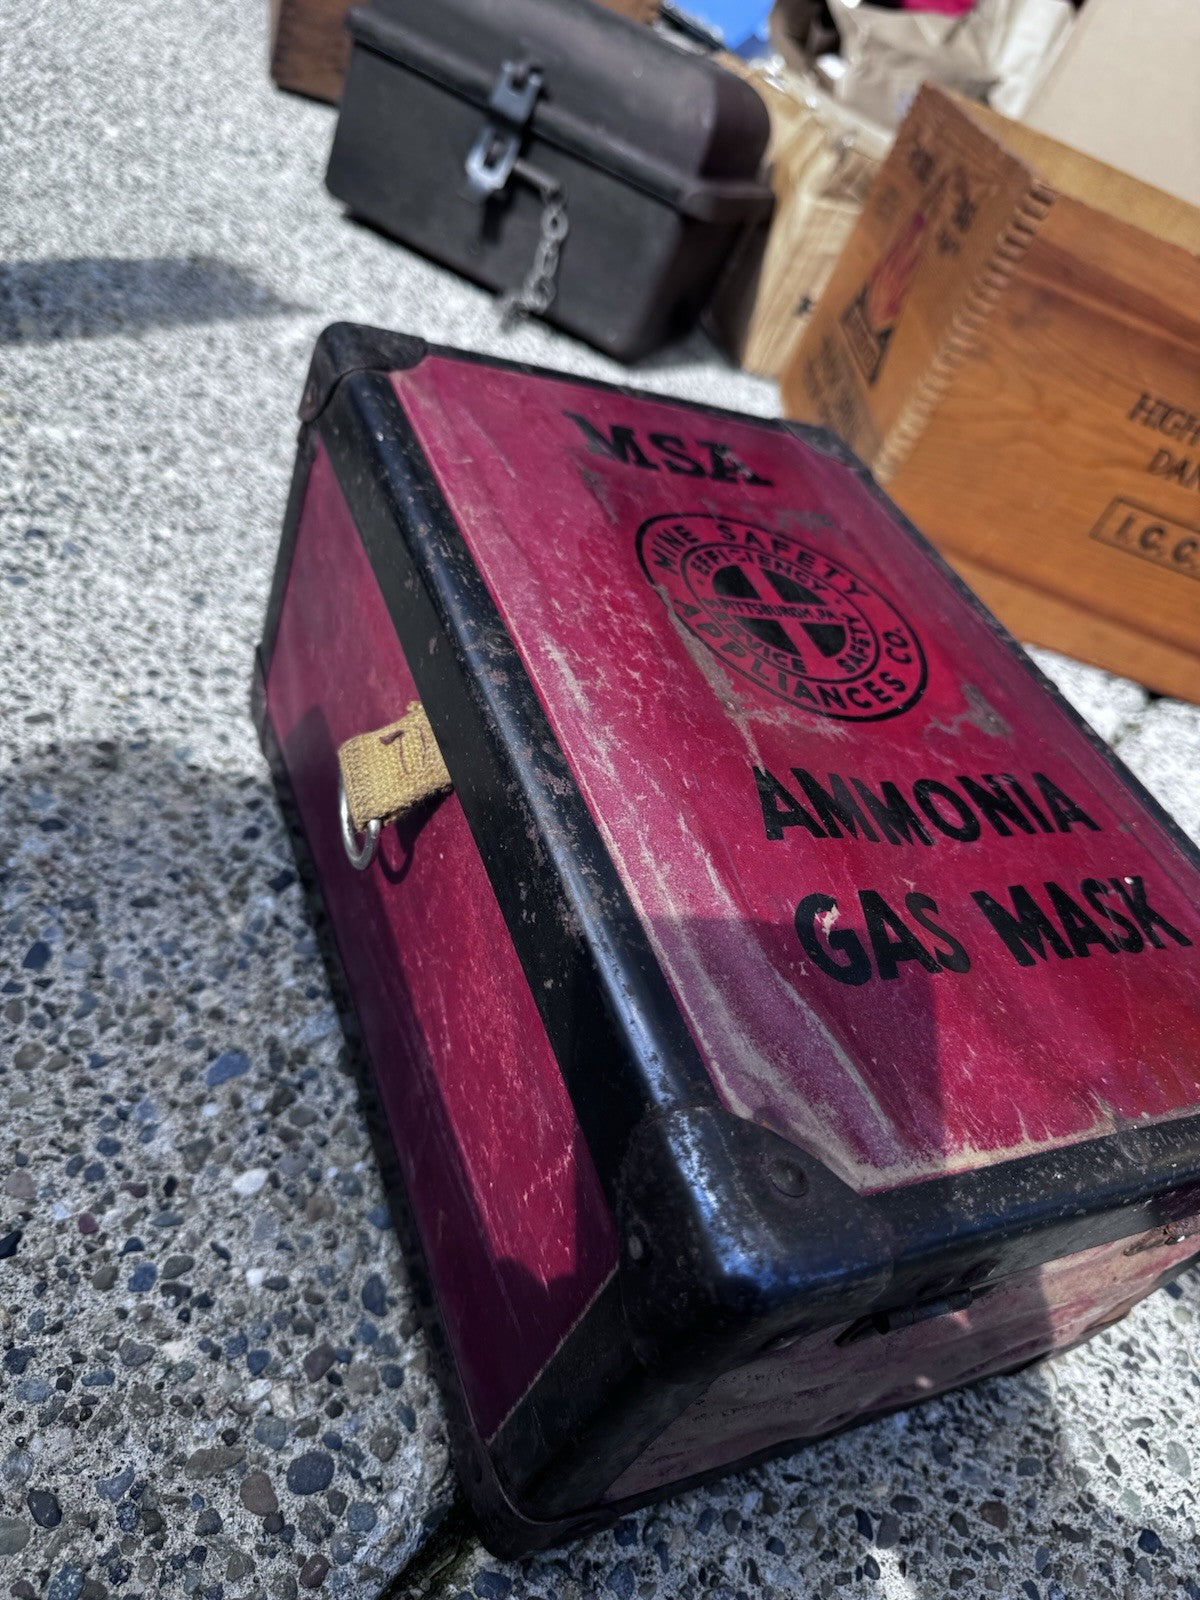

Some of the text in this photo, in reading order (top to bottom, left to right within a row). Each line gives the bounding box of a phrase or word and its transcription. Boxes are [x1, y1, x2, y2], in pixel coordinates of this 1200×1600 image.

[563, 410, 774, 487] MSA
[653, 523, 869, 598] MINE SAFETY
[673, 600, 912, 709] APPLIANCES CO.
[836, 613, 871, 675] SAFETY
[752, 766, 1102, 846] AMMONIA
[794, 875, 1193, 986] GAS MASK
